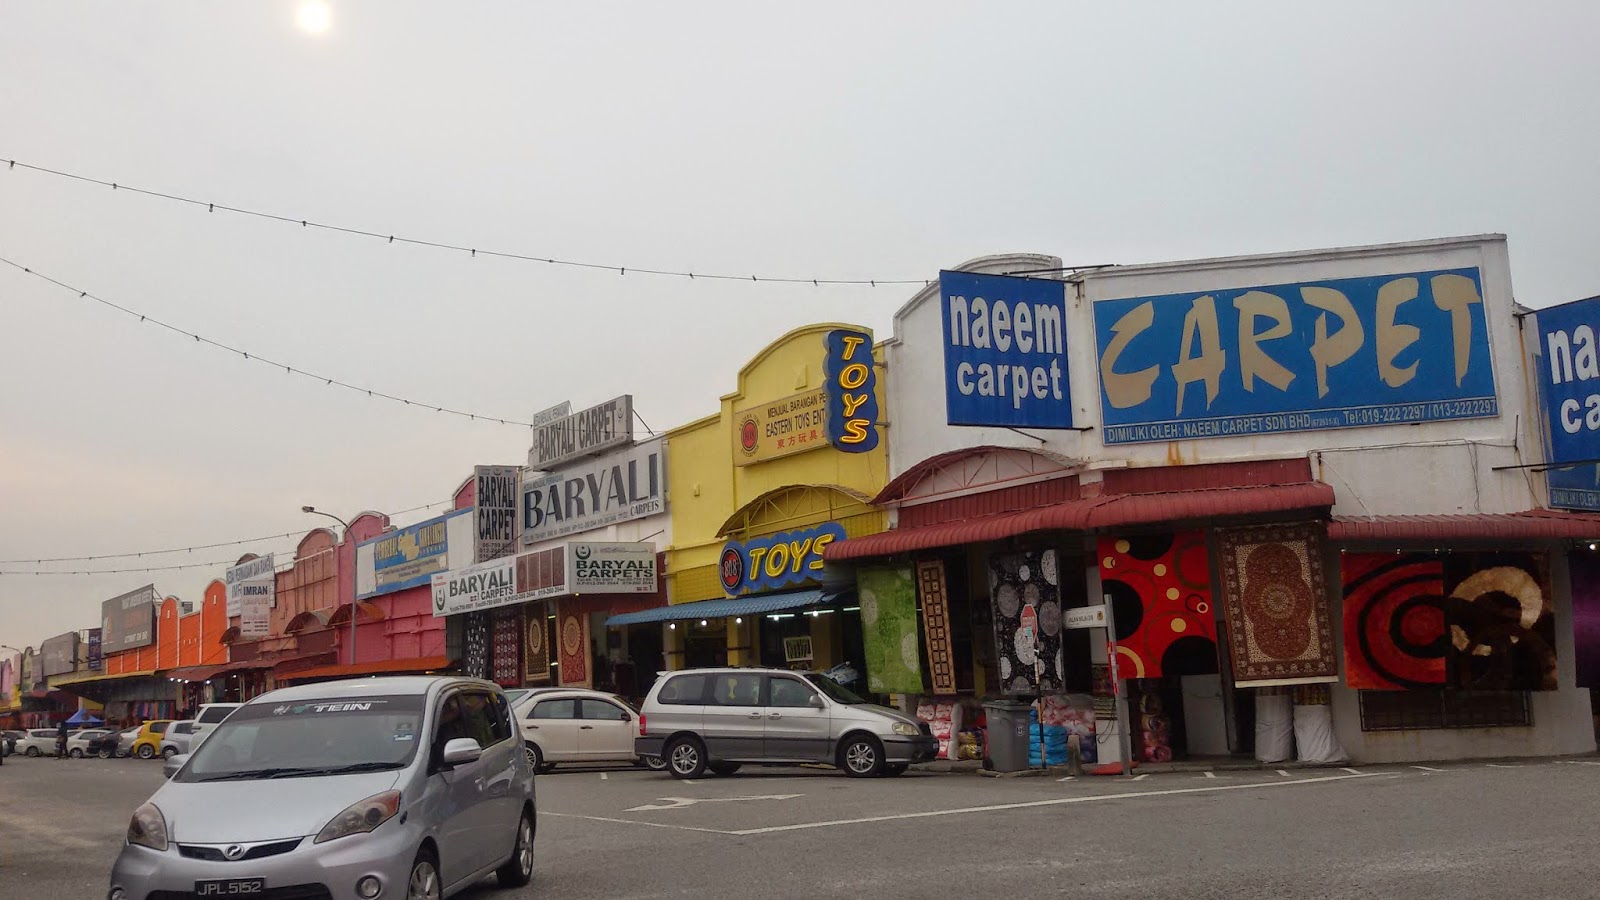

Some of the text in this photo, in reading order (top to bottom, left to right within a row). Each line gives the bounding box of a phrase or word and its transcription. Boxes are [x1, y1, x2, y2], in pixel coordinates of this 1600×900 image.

[949, 295, 1063, 354] naeem
[1101, 274, 1481, 416] CARPET
[838, 336, 869, 443] TOYS
[956, 357, 1063, 409] carpet
[767, 403, 789, 418] MENJUAL
[790, 394, 818, 412] BARANGAN
[538, 416, 576, 464] BARYALI
[578, 401, 617, 449] CARPET
[765, 417, 793, 437] EASTERN
[795, 412, 810, 431] TOYS
[1108, 426, 1149, 443] DIMILIKI
[1150, 423, 1182, 439] OLEH:
[1184, 420, 1220, 437] NAEEM
[1222, 417, 1263, 435] CARPET
[1265, 414, 1288, 431] SDN
[1289, 412, 1311, 429] BHD
[1343, 407, 1401, 425] Tel:019-222
[1402, 404, 1426, 420] 2297
[478, 476, 516, 507] BARYALI
[524, 452, 659, 531] BARYALI
[630, 499, 660, 517] CARPETS
[478, 508, 516, 540] CARPET
[576, 560, 653, 569] BARYALI
[724, 560, 738, 578] 808
[749, 533, 836, 581] TOYS
[449, 566, 513, 597] BARYALI
[576, 569, 654, 578] CARPETS
[243, 585, 268, 596] IMRAN
[481, 586, 514, 601] CARPETS
[197, 881, 262, 896] JPL 5152
